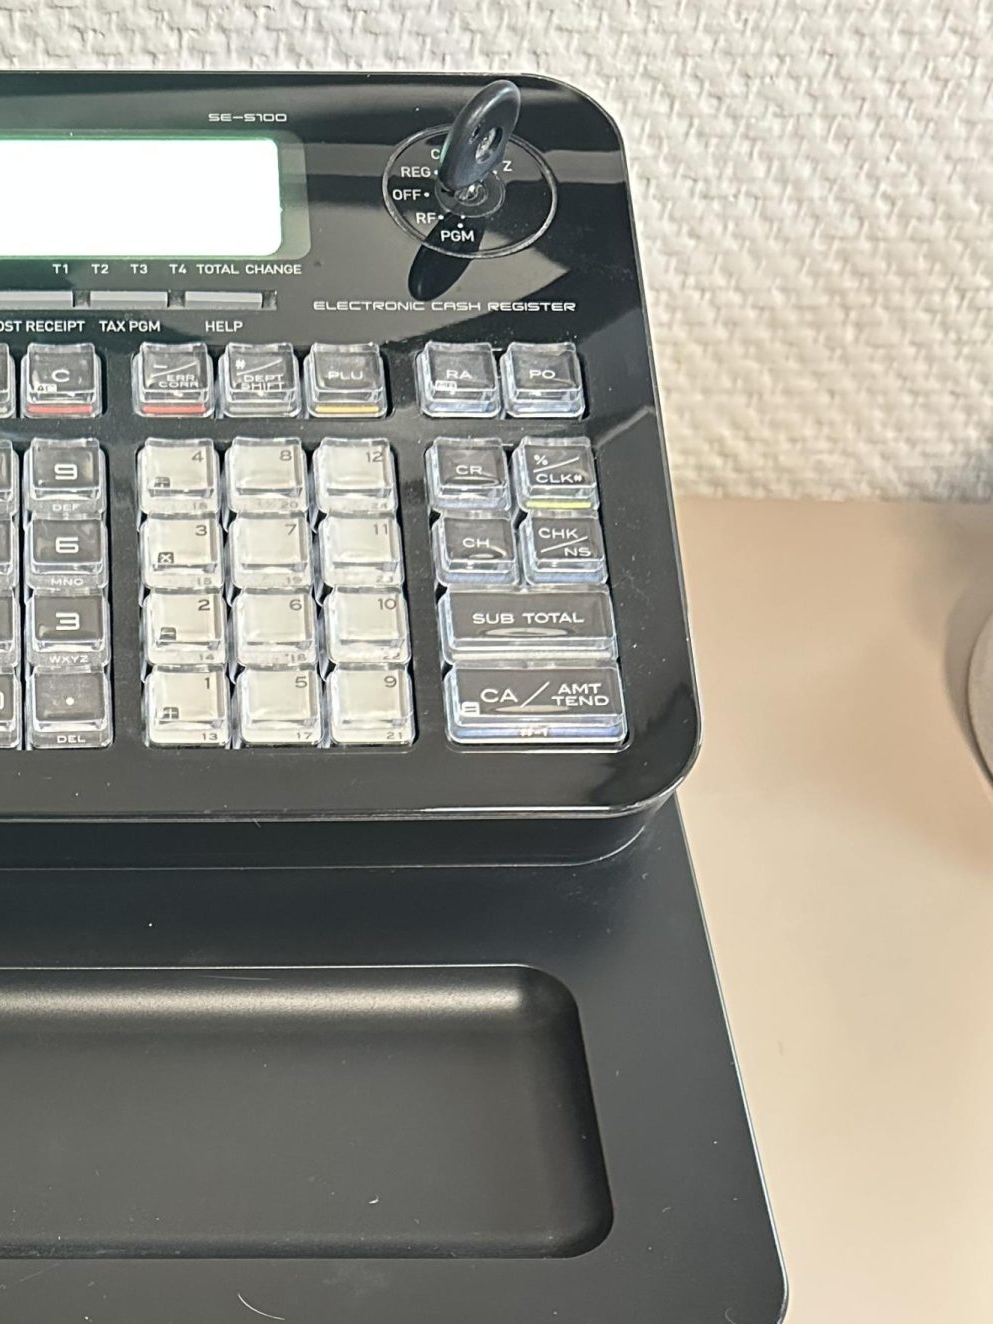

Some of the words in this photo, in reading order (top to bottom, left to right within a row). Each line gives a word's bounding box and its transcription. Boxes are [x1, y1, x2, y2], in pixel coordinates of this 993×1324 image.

[208, 113, 287, 122] SE-S100
[402, 166, 431, 178] REG
[503, 161, 512, 172] Z
[393, 190, 421, 201] OFF
[416, 213, 436, 224] RF
[440, 230, 475, 242] PGM
[53, 264, 69, 275] T1
[92, 264, 109, 275] T2
[131, 264, 148, 275] T3
[170, 264, 187, 275] T4
[196, 264, 239, 275] TOTAL
[245, 264, 302, 275] CHANGE
[313, 300, 426, 312] ELECTRONIC
[432, 301, 481, 312] CASH
[488, 301, 576, 312] REGISTER
[25, 321, 85, 332] RECEIPT
[99, 321, 126, 333] TAX
[129, 321, 161, 333] PGM
[205, 321, 243, 332] HELP
[52, 369, 71, 382] C
[166, 374, 195, 382] ERR
[328, 371, 363, 380] PLU
[446, 369, 472, 379] RA
[529, 370, 556, 379] PO
[241, 382, 284, 391] SHIFT
[192, 451, 204, 462] 4
[279, 450, 292, 461] 8
[366, 451, 384, 462] 12
[54, 464, 78, 480] 9
[456, 465, 483, 475] CR
[52, 504, 80, 512] DEF
[195, 525, 207, 536] 3
[284, 524, 296, 535] 7
[373, 523, 388, 535] 11
[538, 528, 579, 539] CHK
[55, 537, 79, 553] 6
[462, 538, 490, 549] CH
[564, 547, 591, 557] NS
[51, 578, 83, 586] MNO
[198, 599, 210, 611] 2
[289, 599, 302, 610] 6
[378, 598, 397, 610] 10
[56, 612, 80, 631] 3
[472, 613, 515, 624] SUB
[522, 612, 584, 624] TOTAL
[49, 655, 89, 663] WXYZ
[204, 677, 210, 689] 1
[295, 676, 307, 688] 5
[384, 676, 397, 688] 9
[557, 683, 602, 694] AMT
[480, 688, 518, 703] CA
[551, 695, 609, 706] TEND
[57, 735, 86, 743] DEL
[202, 733, 218, 741] 13
[387, 732, 402, 740] 21
